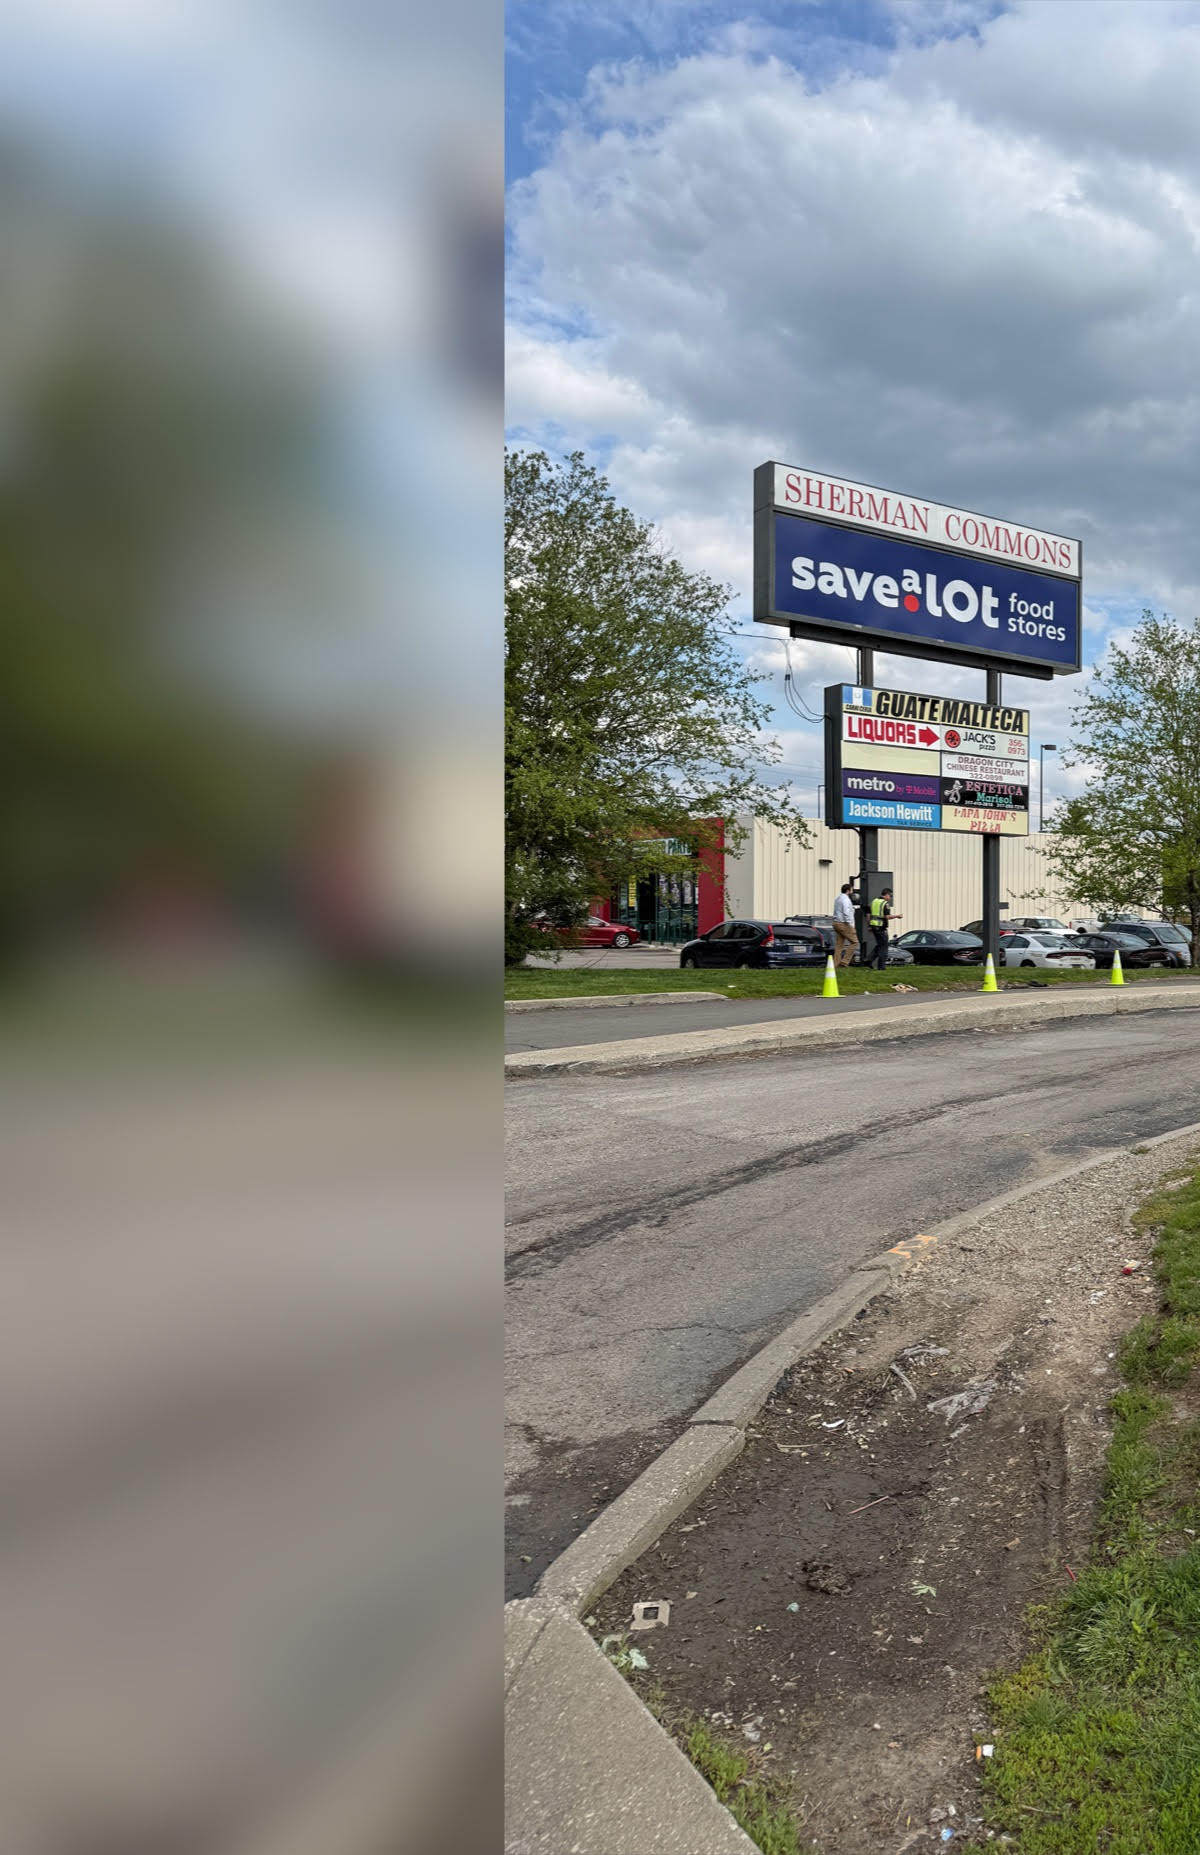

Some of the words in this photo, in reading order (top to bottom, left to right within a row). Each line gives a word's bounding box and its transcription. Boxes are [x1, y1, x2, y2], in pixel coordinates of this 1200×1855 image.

[785, 473, 929, 534] SHERMAN
[945, 513, 1071, 569] COMMONS
[1008, 592, 1054, 621] food
[1007, 616, 1067, 641] stores
[848, 716, 916, 744] LIQUORS
[963, 731, 996, 745] JACK'S
[958, 756, 993, 767] DRAGON
[995, 760, 1015, 768] CITY
[947, 763, 978, 773] CHINESE
[980, 766, 1025, 777] RESTAURANT
[847, 777, 895, 792] metro
[965, 781, 1024, 796] ESTETICA
[976, 792, 1013, 804] Marisol
[849, 800, 895, 819] Jackson
[896, 804, 933, 821] Hewitt
